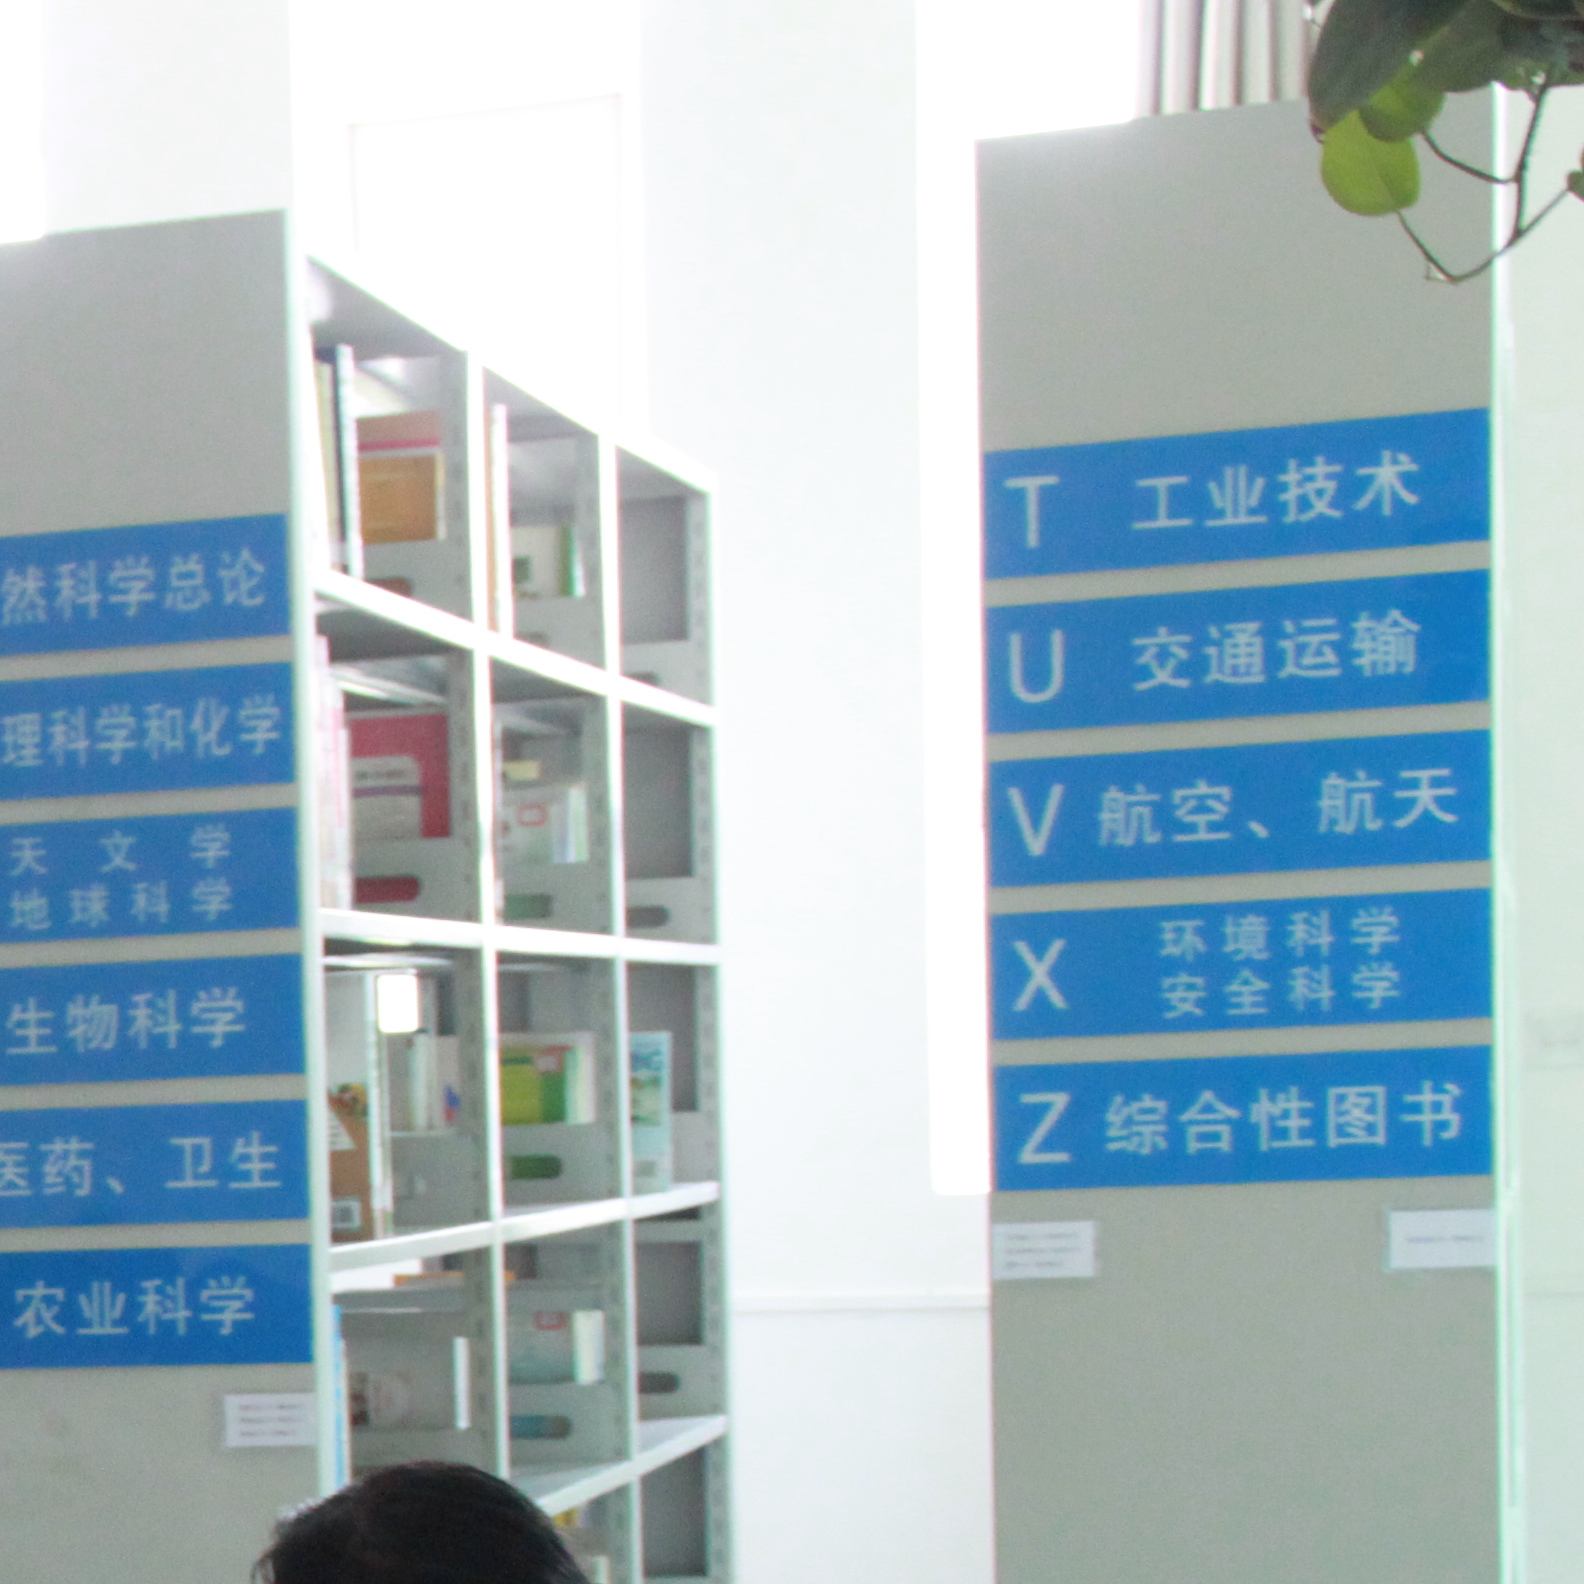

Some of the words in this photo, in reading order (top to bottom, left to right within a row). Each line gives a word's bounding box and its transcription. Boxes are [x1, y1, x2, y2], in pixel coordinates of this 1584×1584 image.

[1003, 474, 1060, 548] T
[1132, 449, 1421, 530] 工业技术
[1009, 628, 1065, 703] U
[1131, 608, 1421, 692] 交通运输
[1006, 783, 1063, 856] V
[9, 877, 231, 930] 地球科学
[1012, 938, 1069, 1012] X
[1158, 905, 1402, 963] 环境科学
[1159, 962, 1402, 1020] 安全科学
[4, 987, 246, 1056] 生物科学
[1017, 1092, 1072, 1165] Z
[1104, 1079, 1463, 1157] 综合性图书
[12, 1275, 256, 1338] 农业科学
